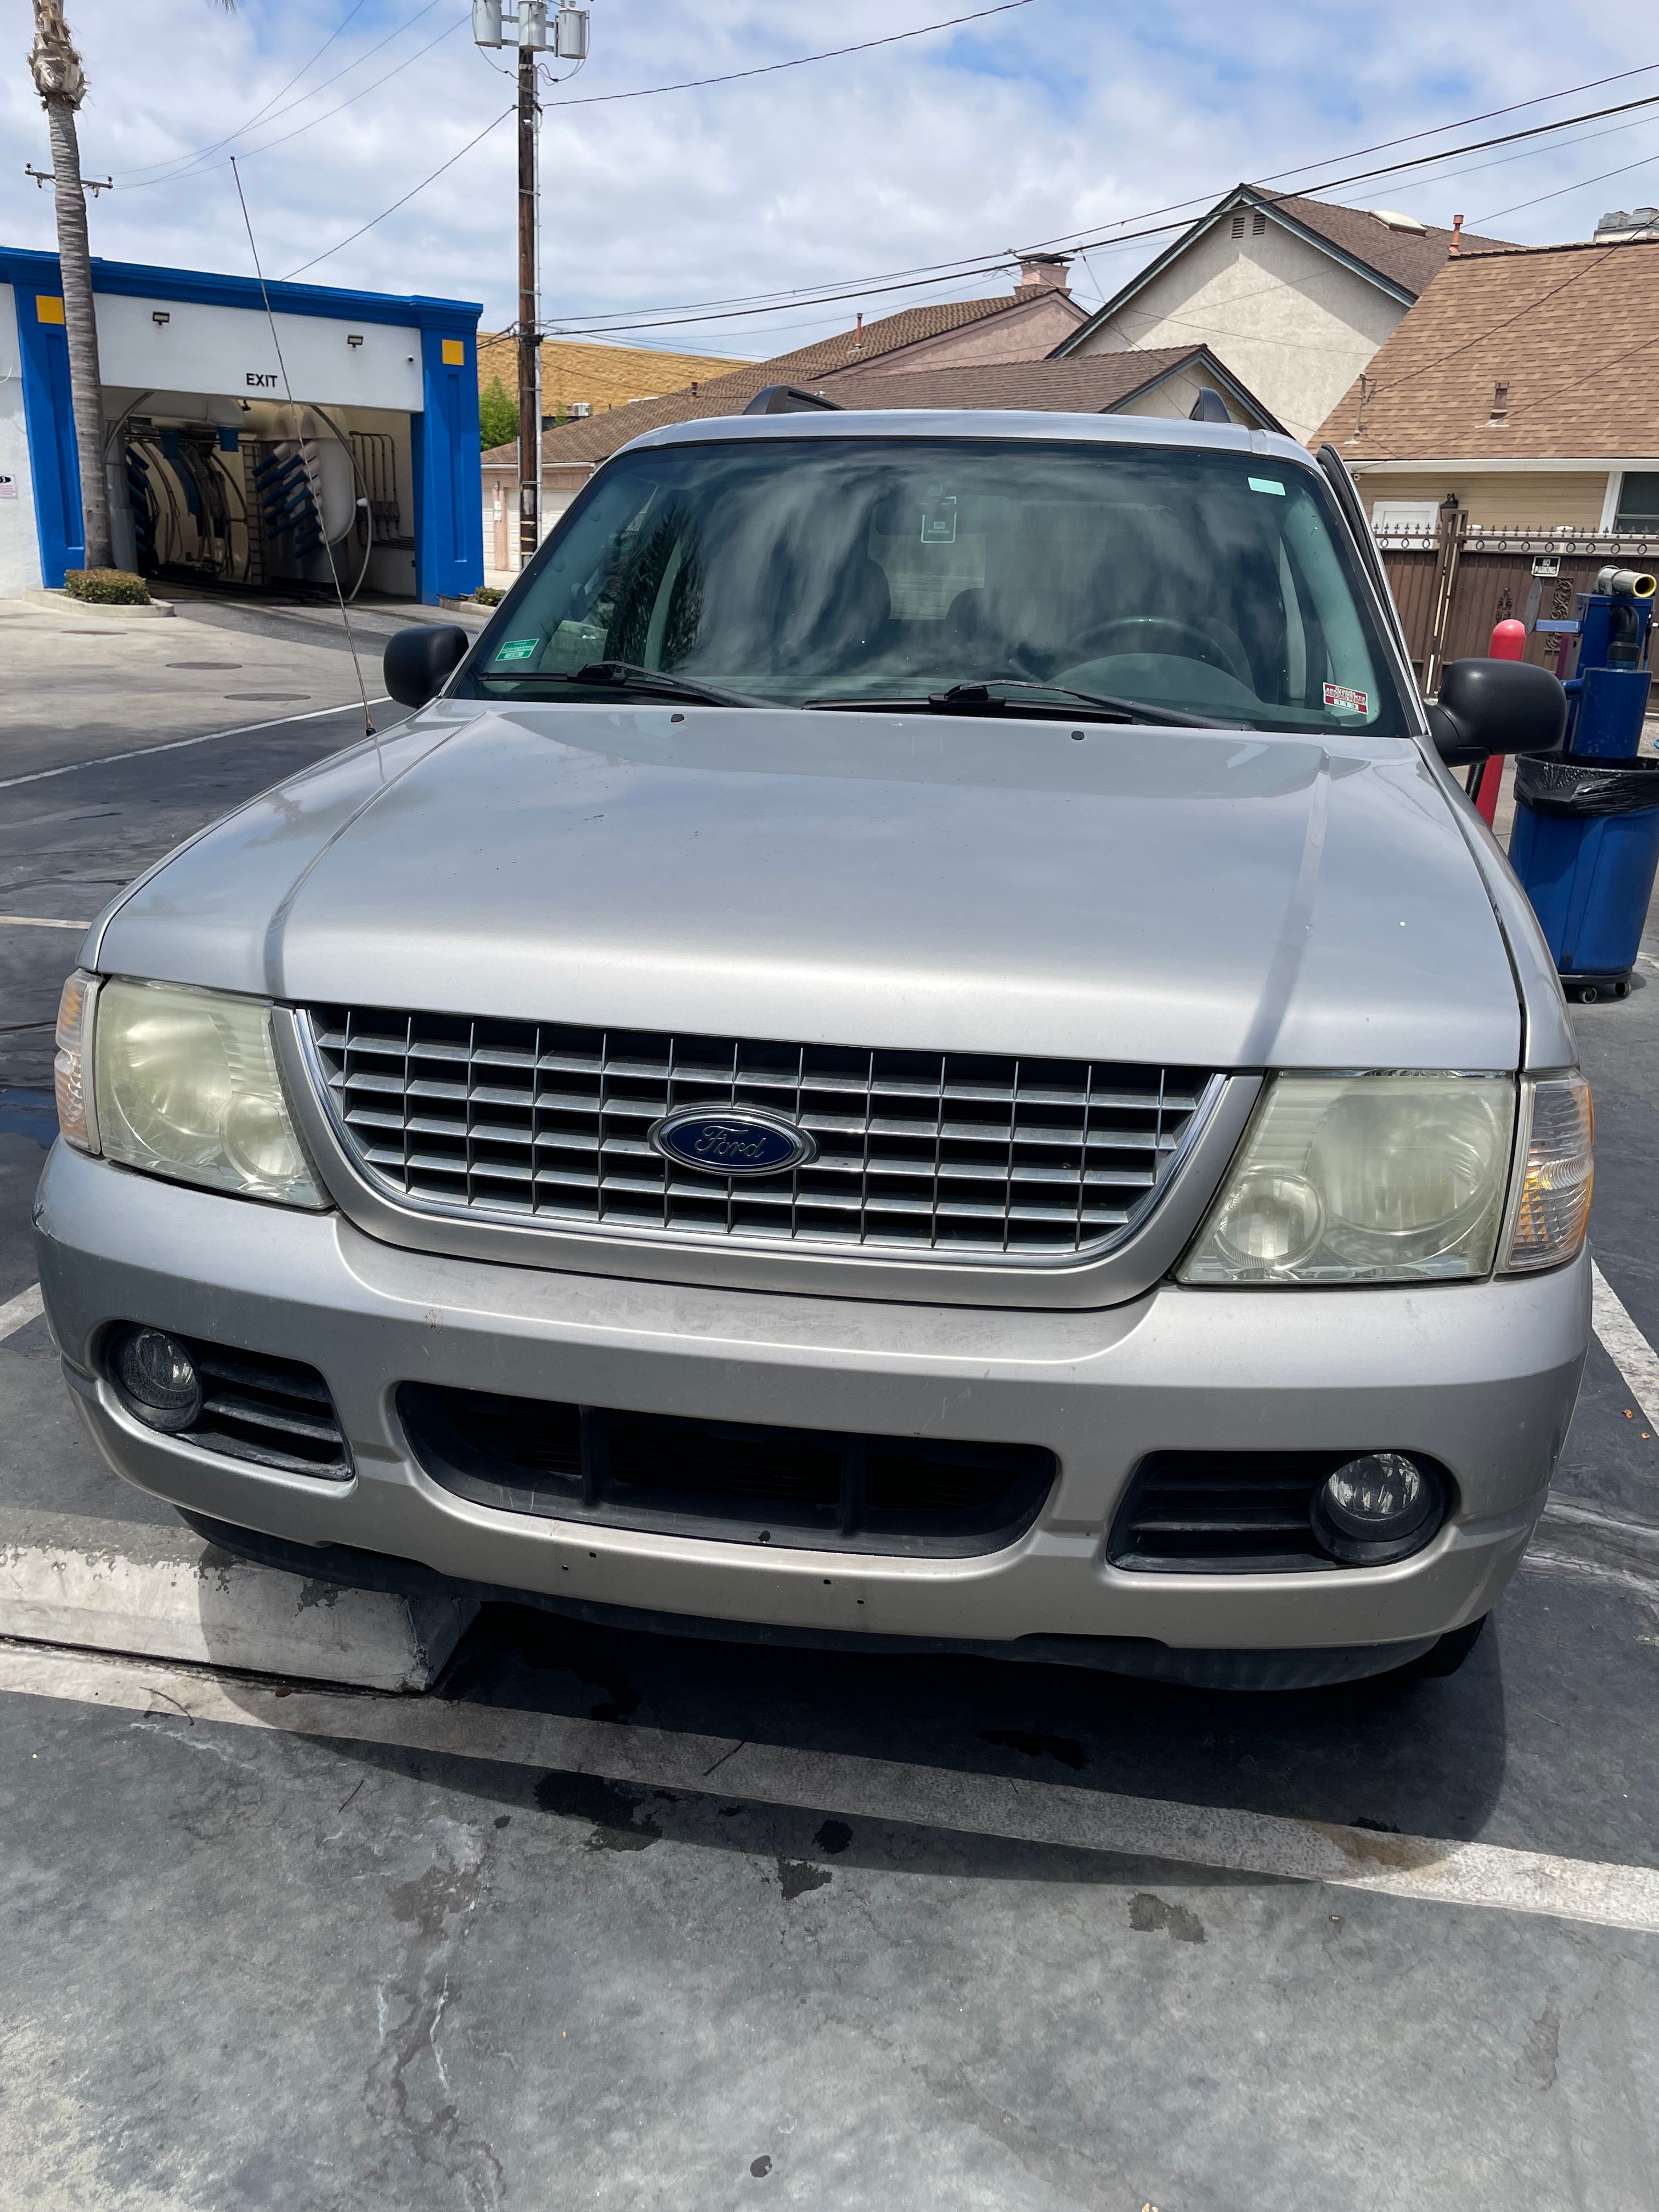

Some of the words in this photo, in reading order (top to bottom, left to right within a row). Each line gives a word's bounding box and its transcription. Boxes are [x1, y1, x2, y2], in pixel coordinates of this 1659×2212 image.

[246, 373, 278, 387] EXIT
[1326, 687, 1365, 700] APARTMENTS
[695, 1125, 766, 1158] Ford
